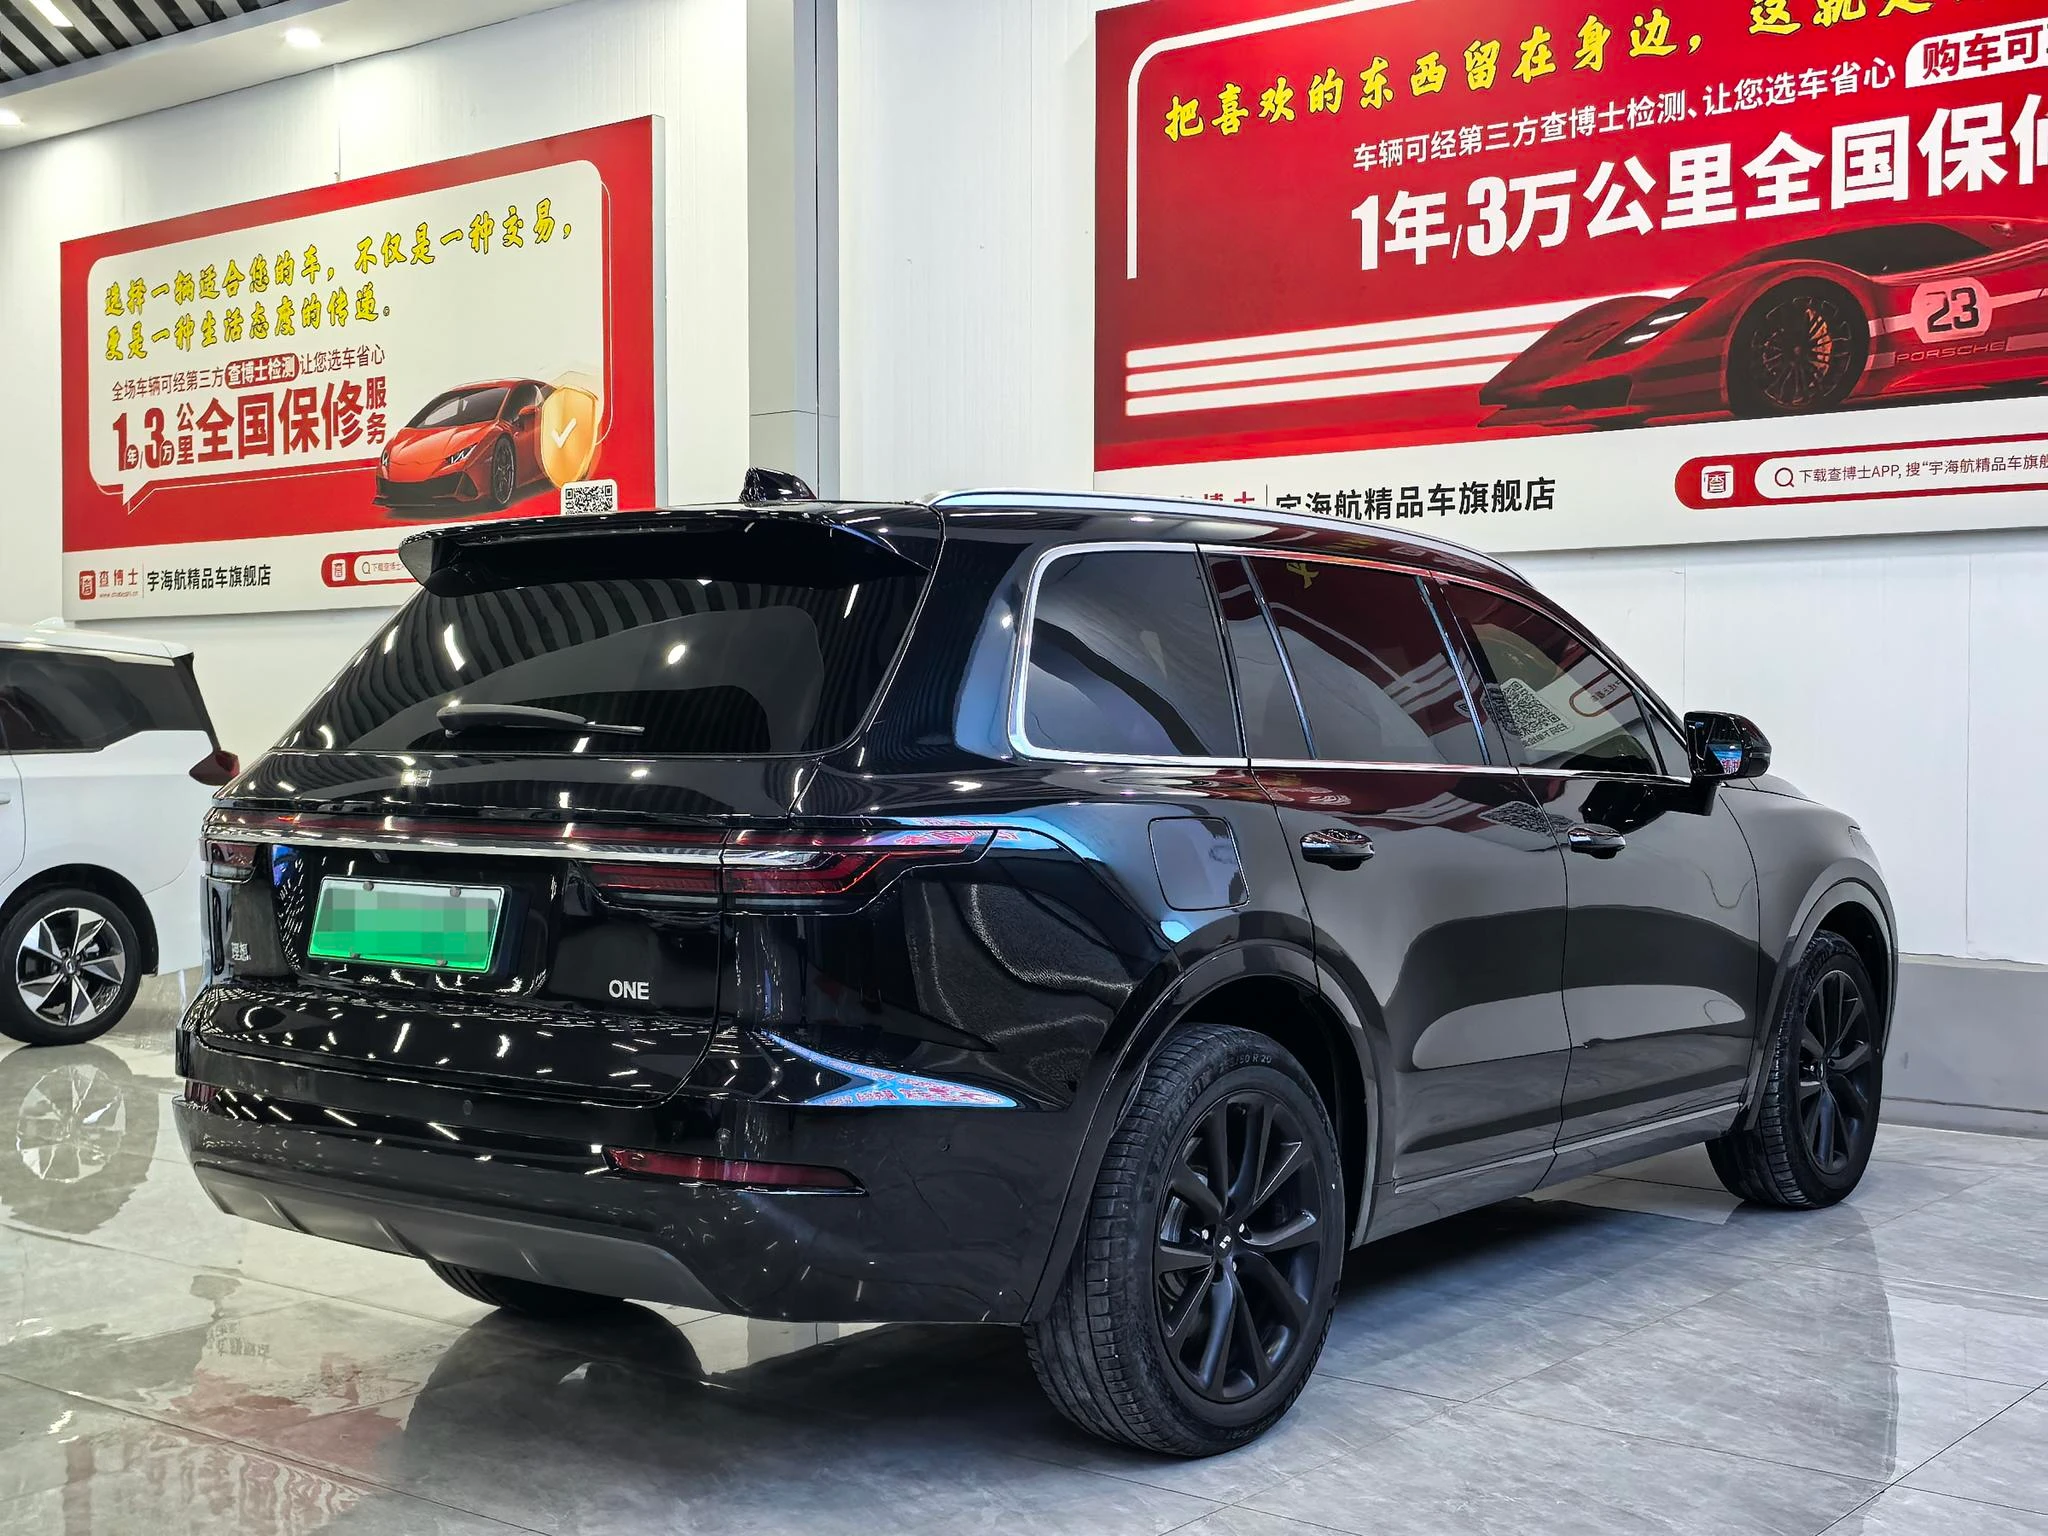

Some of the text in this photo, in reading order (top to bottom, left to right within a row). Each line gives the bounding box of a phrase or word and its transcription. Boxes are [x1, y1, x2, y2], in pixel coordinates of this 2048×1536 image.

[1353, 25, 2048, 171] 车辆可经第三方查博士检测、让您选车省心 购车可
[1926, 287, 1979, 333] 23
[1896, 341, 2006, 364] PORSCHE
[608, 979, 650, 1000] ONE
